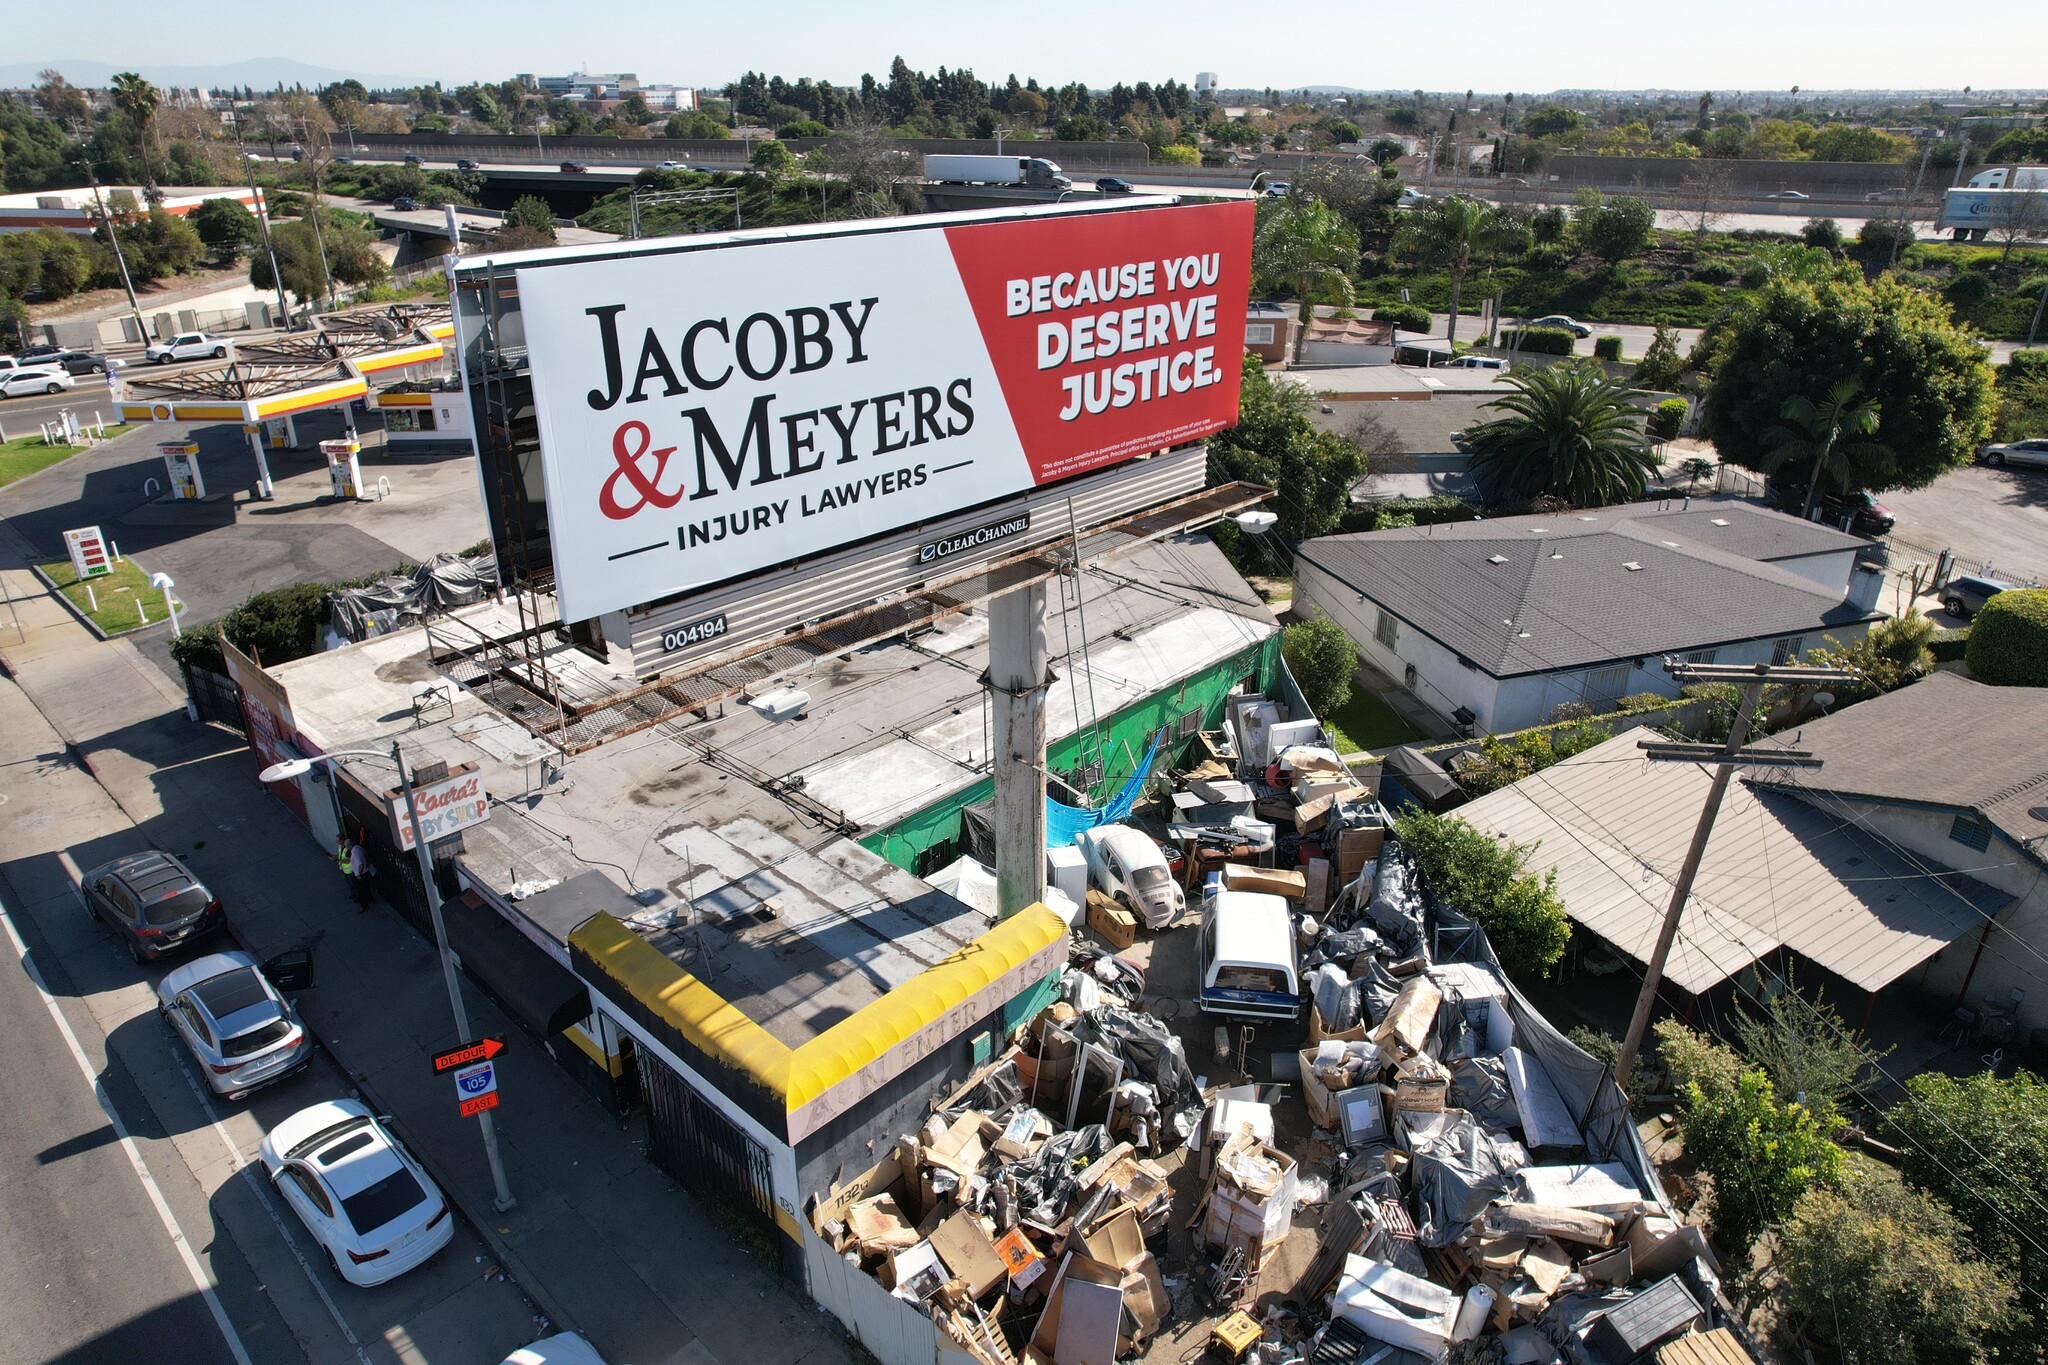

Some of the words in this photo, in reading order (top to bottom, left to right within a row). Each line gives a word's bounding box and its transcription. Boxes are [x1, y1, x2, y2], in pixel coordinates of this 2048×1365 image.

[1006, 261, 1155, 317] BECAUSE
[1162, 252, 1220, 291] YOU
[585, 297, 879, 410] JACOBY
[1037, 295, 1217, 370] DESERVE
[1059, 345, 1222, 422] JUSTICE.
[599, 420, 685, 520] &
[681, 377, 975, 501] MEYERS
[1041, 468, 1057, 478] Jacoby
[1062, 463, 1077, 472] Meyers
[1078, 460, 1090, 468] Injury
[1110, 448, 1129, 458] Principal
[1172, 428, 1199, 440] Advertisement
[1073, 451, 1095, 461] constitute
[1099, 444, 1120, 454] guarantee
[1125, 436, 1146, 447] prediction
[1146, 430, 1166, 440] regarding
[1172, 425, 1189, 433] outcome
[678, 499, 789, 550] INJURY
[801, 464, 927, 517] LAWYERS
[665, 618, 725, 651] 004194
[401, 814, 444, 845] BBY
[446, 799, 487, 828] SHOP
[402, 778, 480, 821] Laura's
[441, 1046, 486, 1067] DETOUR
[466, 1076, 487, 1091] 105
[467, 1097, 491, 1113] EAST
